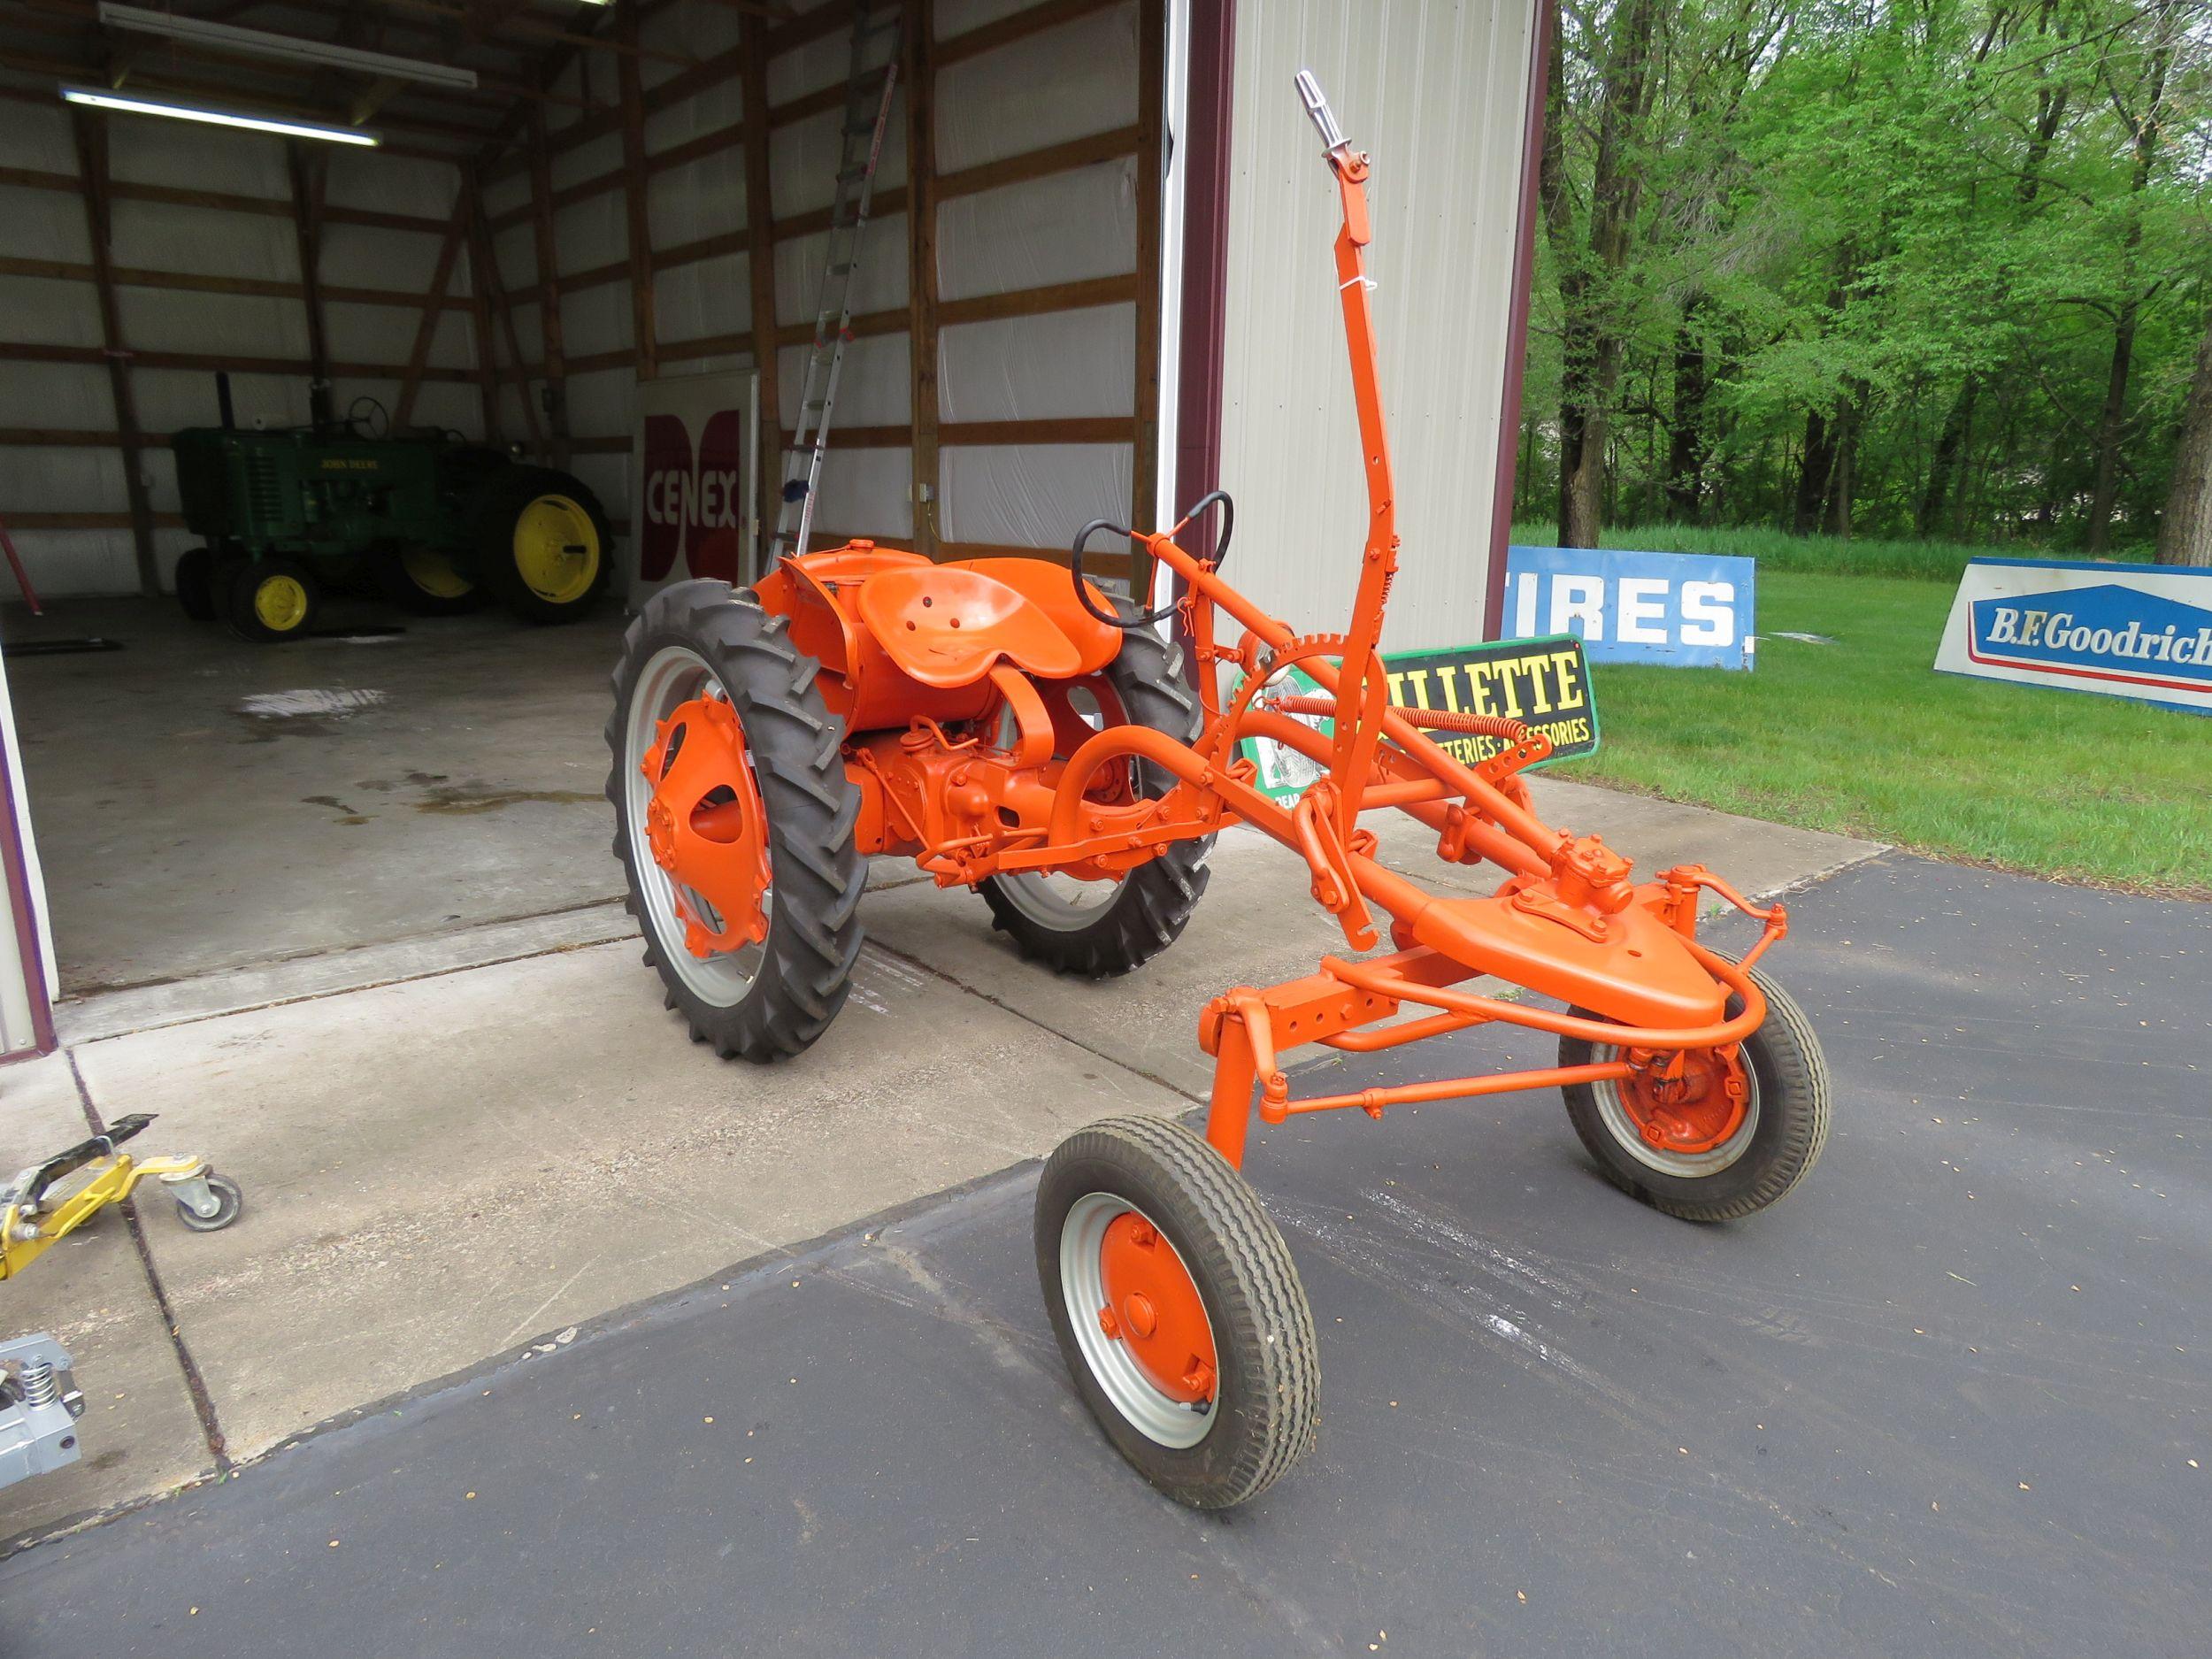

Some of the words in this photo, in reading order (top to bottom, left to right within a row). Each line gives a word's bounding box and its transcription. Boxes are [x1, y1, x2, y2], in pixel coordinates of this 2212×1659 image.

[647, 469, 737, 529] CENEX
[1505, 572, 1734, 648] IRES
[1360, 650, 1585, 741] ILLETTE
[1439, 734, 1497, 765] TERIES
[1503, 718, 1590, 752] AESORIES
